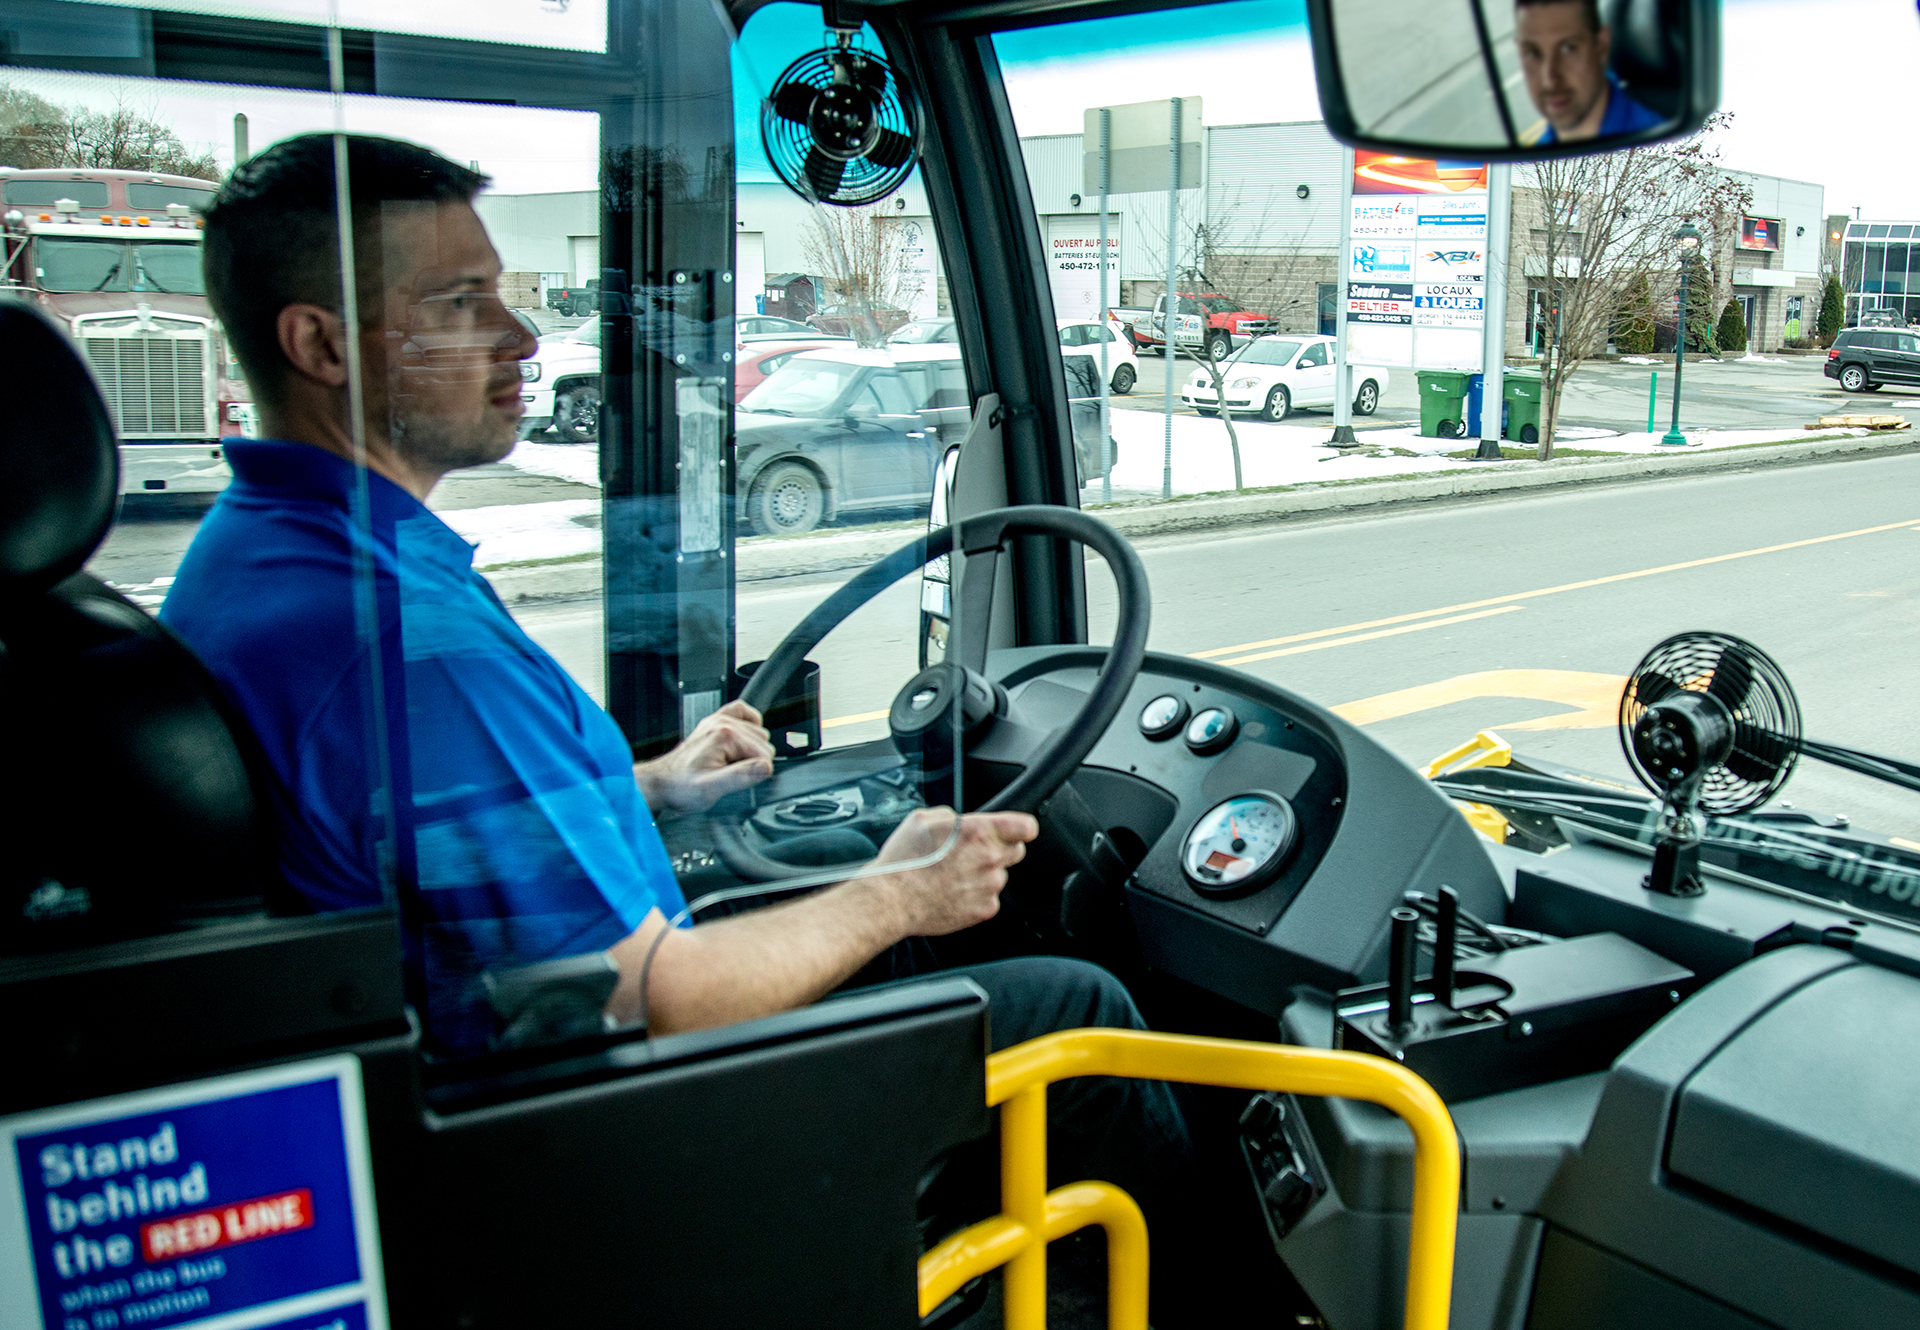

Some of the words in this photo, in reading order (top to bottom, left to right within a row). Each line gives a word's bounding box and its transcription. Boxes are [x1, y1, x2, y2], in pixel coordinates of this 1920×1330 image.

[1053, 239, 1083, 248] OUVERT
[1084, 239, 1095, 247] AU
[1059, 262, 1116, 270] 450-472-111
[1350, 284, 1390, 299] Soudure
[1427, 286, 1473, 295] LOCAUX
[1350, 301, 1400, 312] PELTIER
[1420, 297, 1430, 308] à
[1432, 298, 1480, 309] LOUER
[38, 1121, 179, 1188] Stand
[46, 1161, 209, 1233] behind
[53, 1233, 134, 1279] the
[148, 1213, 222, 1259] RED
[222, 1194, 305, 1241] LINE
